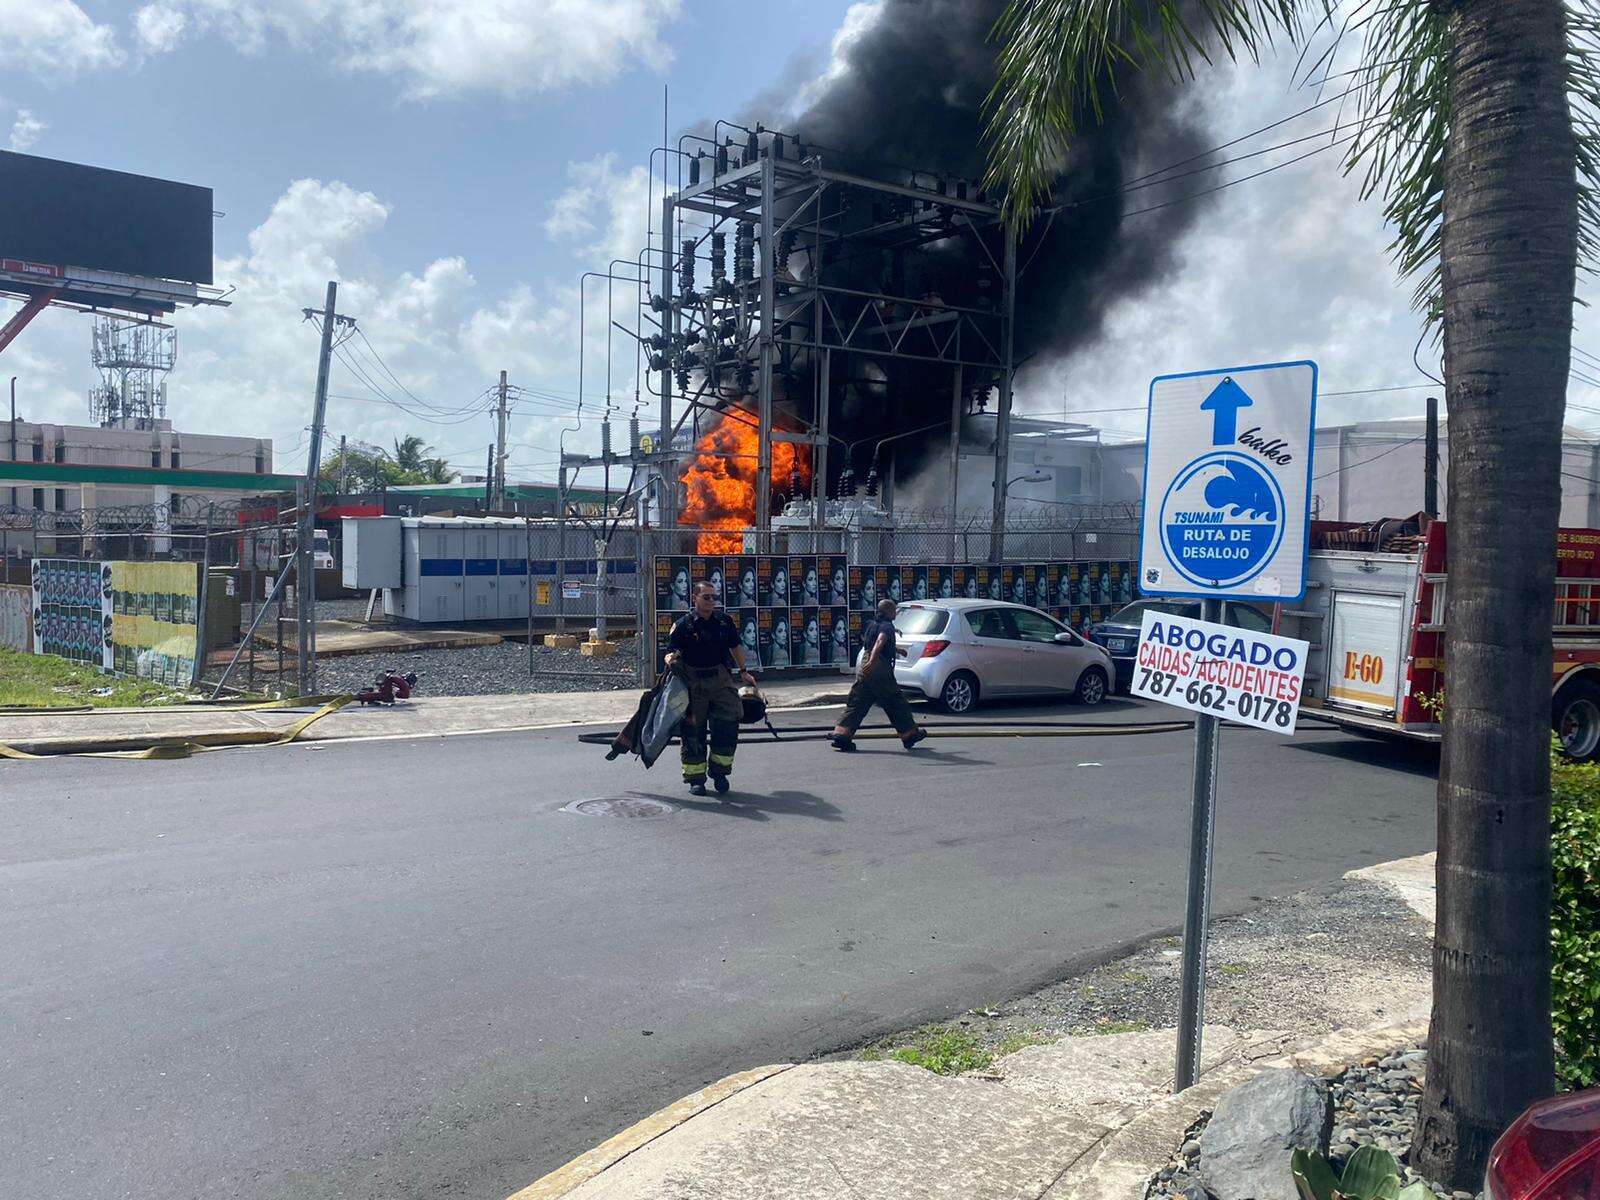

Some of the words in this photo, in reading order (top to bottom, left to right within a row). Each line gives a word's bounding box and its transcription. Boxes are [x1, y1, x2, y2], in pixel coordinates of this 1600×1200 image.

[1174, 511, 1225, 524] TSUNAMI
[1183, 529, 1226, 541] RUTA
[1230, 529, 1252, 541] DE
[1182, 546, 1250, 560] DESALOJO
[1555, 549, 1576, 559] ERTO
[1147, 621, 1298, 671] ABOGADO
[1343, 651, 1383, 684] E-60
[1138, 667, 1292, 728] 787-662-0178
